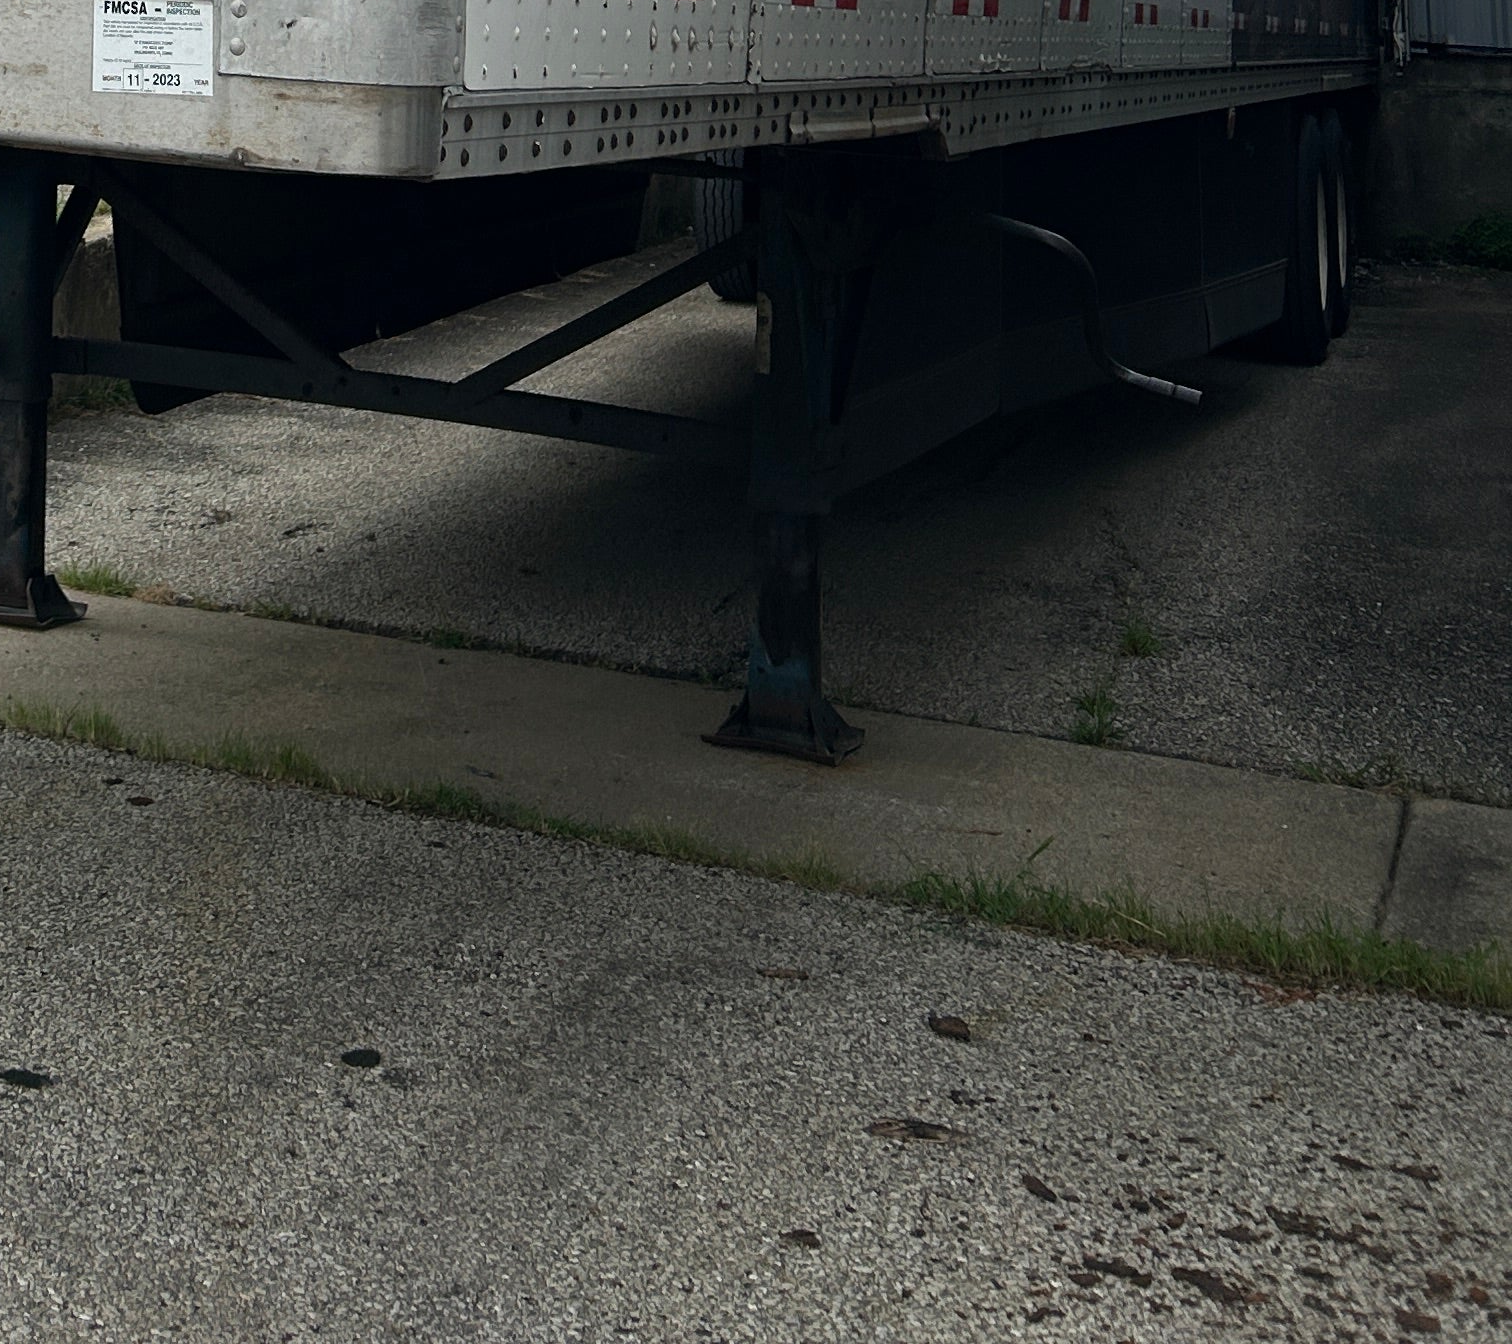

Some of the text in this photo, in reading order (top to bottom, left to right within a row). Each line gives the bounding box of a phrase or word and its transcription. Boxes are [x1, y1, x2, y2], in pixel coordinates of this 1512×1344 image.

[104, 0, 148, 15] FMCSA
[127, 73, 140, 87] 11
[152, 73, 181, 87] 2023
[193, 79, 209, 87] YEAR
